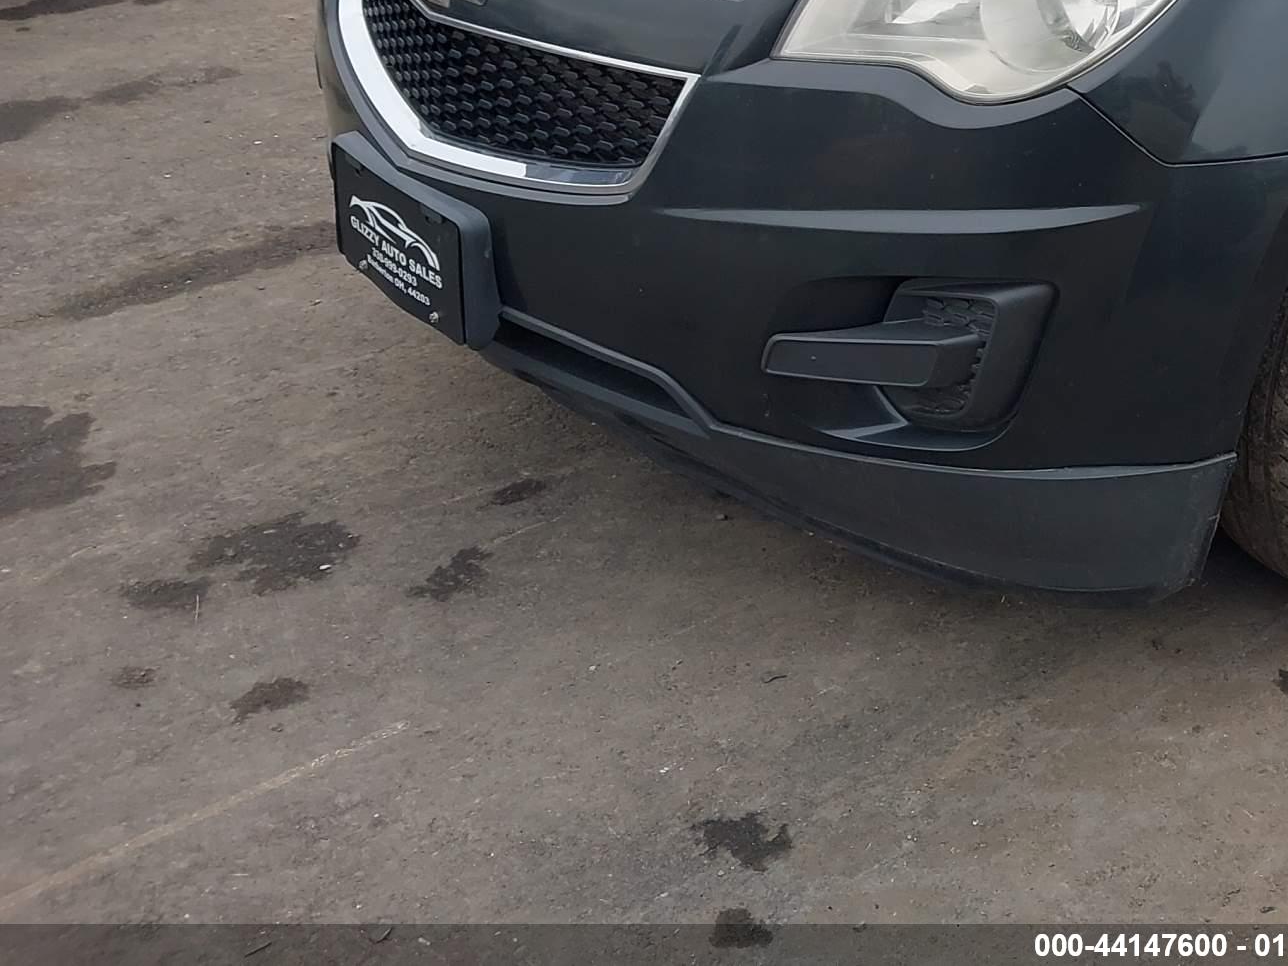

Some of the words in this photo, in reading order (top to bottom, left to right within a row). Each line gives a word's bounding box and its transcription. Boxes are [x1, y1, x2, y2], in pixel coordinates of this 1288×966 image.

[351, 216, 379, 246] GLIZZY
[381, 240, 407, 266] AUTO
[409, 259, 442, 288] SALES
